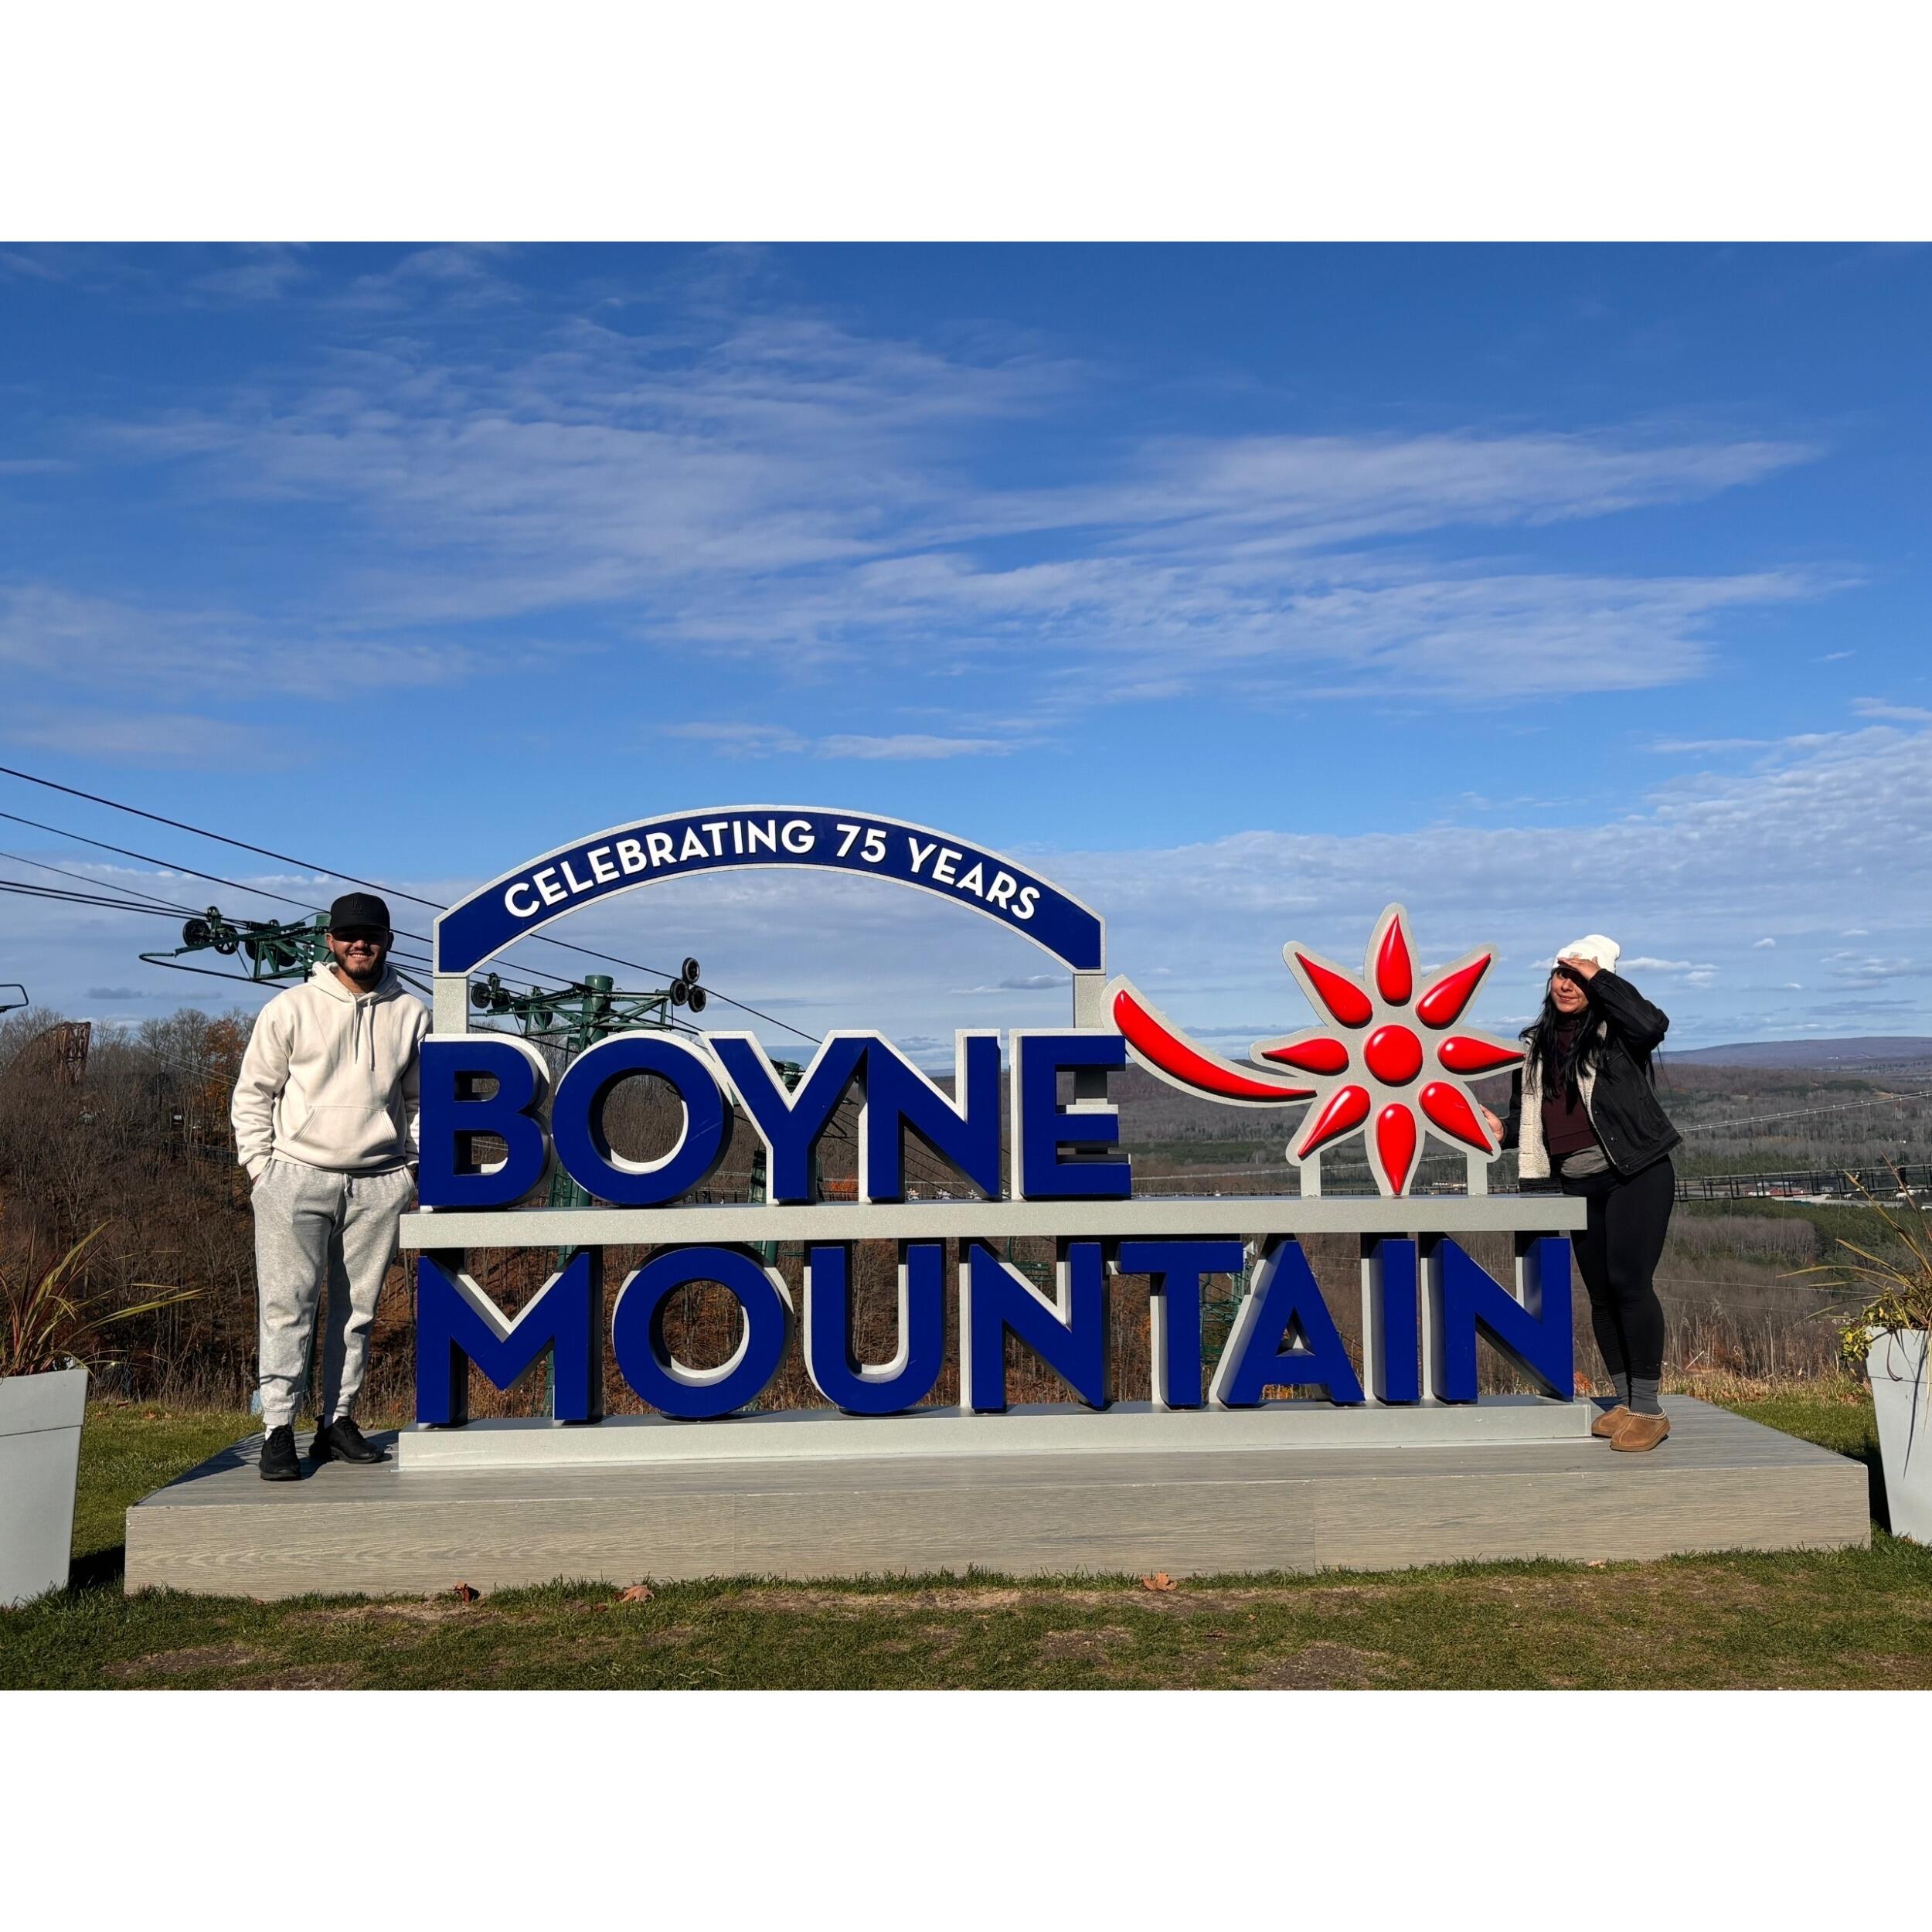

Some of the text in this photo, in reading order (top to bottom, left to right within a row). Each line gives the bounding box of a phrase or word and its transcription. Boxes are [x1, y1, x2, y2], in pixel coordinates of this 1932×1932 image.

[349, 897, 366, 915] LA
[504, 819, 1040, 920] CELEBRATING 75 YEARS
[419, 1035, 1131, 1206] BOYNE
[417, 1238, 1574, 1424] MOUNTAIN
